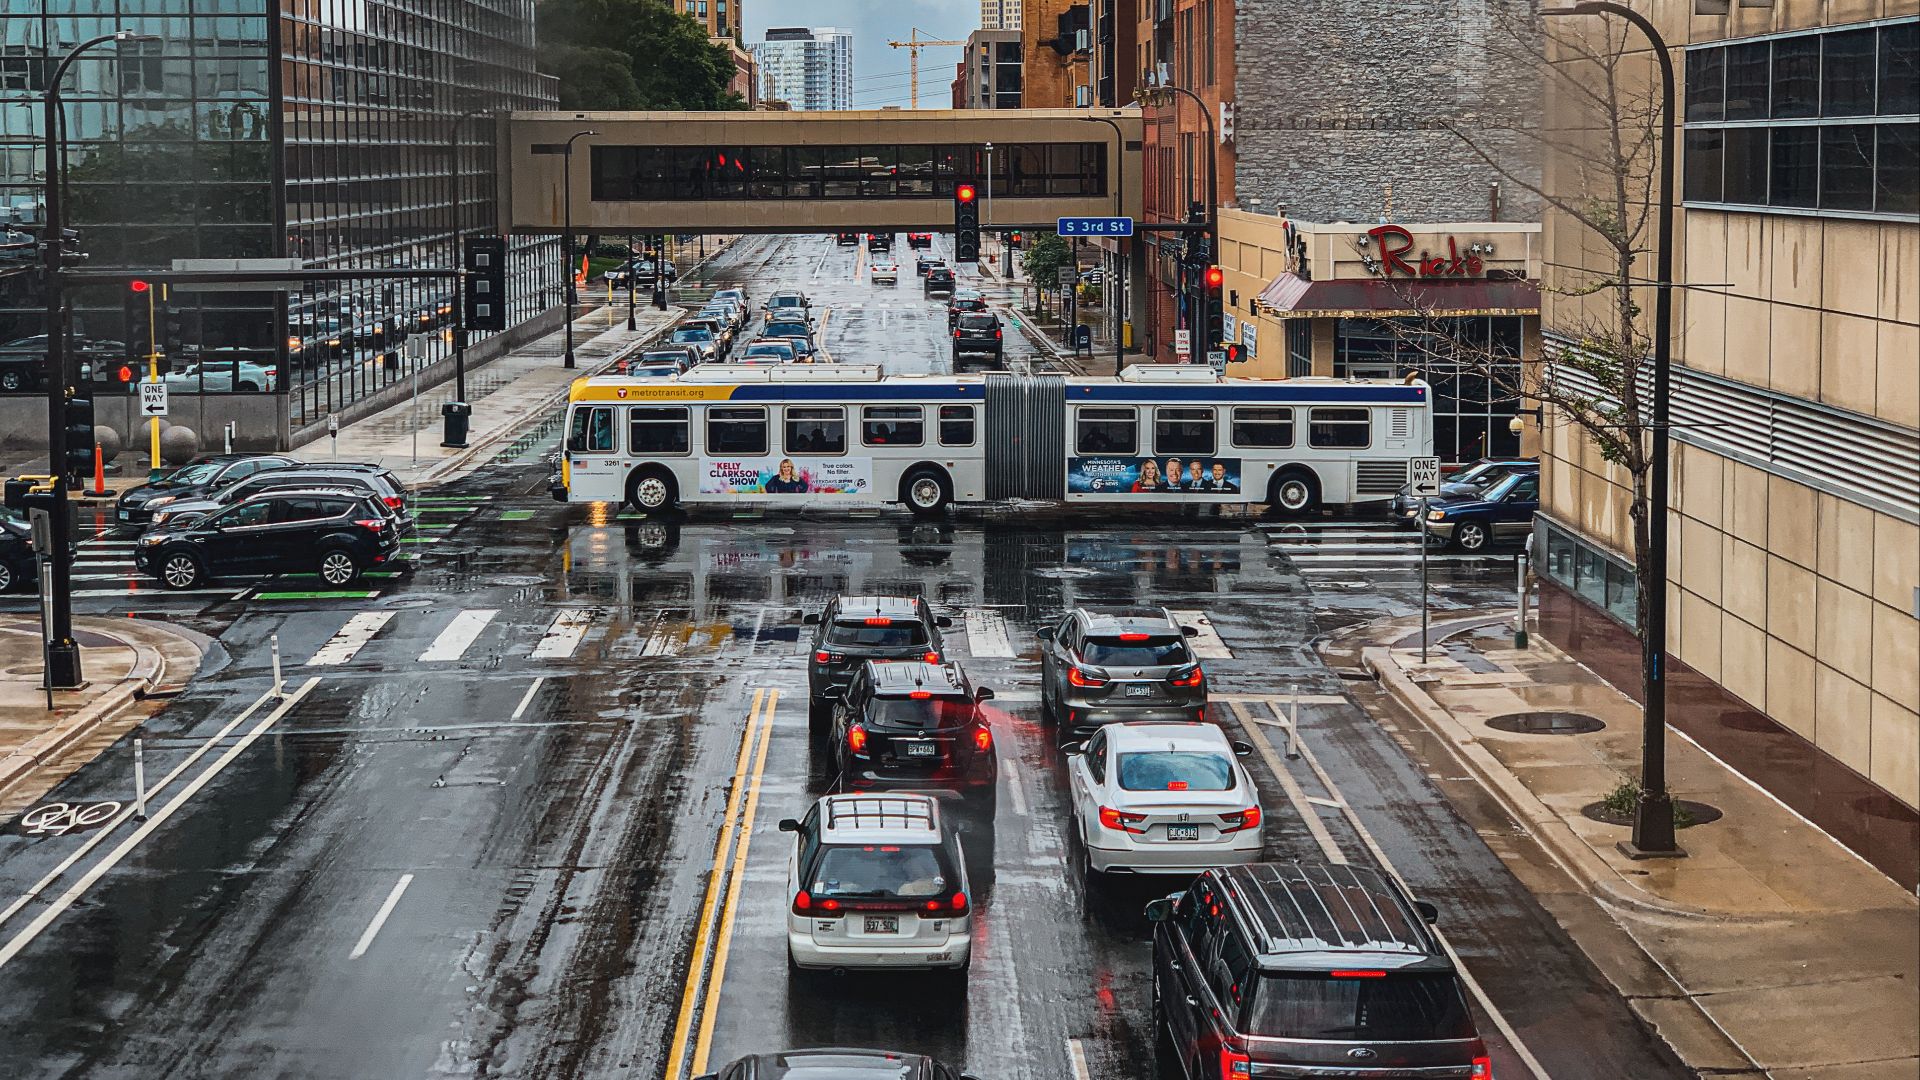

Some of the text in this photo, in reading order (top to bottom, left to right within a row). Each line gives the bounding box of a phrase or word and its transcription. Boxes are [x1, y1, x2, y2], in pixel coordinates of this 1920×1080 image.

[1066, 221, 1124, 231] S 3rd St
[144, 385, 163, 393] ONE
[631, 389, 704, 398] metrotransit.org
[144, 394, 164, 402] WAY
[717, 462, 741, 470] KELLY
[1414, 460, 1437, 470] ONE
[709, 470, 760, 478] CLARKSON
[1413, 470, 1437, 481] WAY
